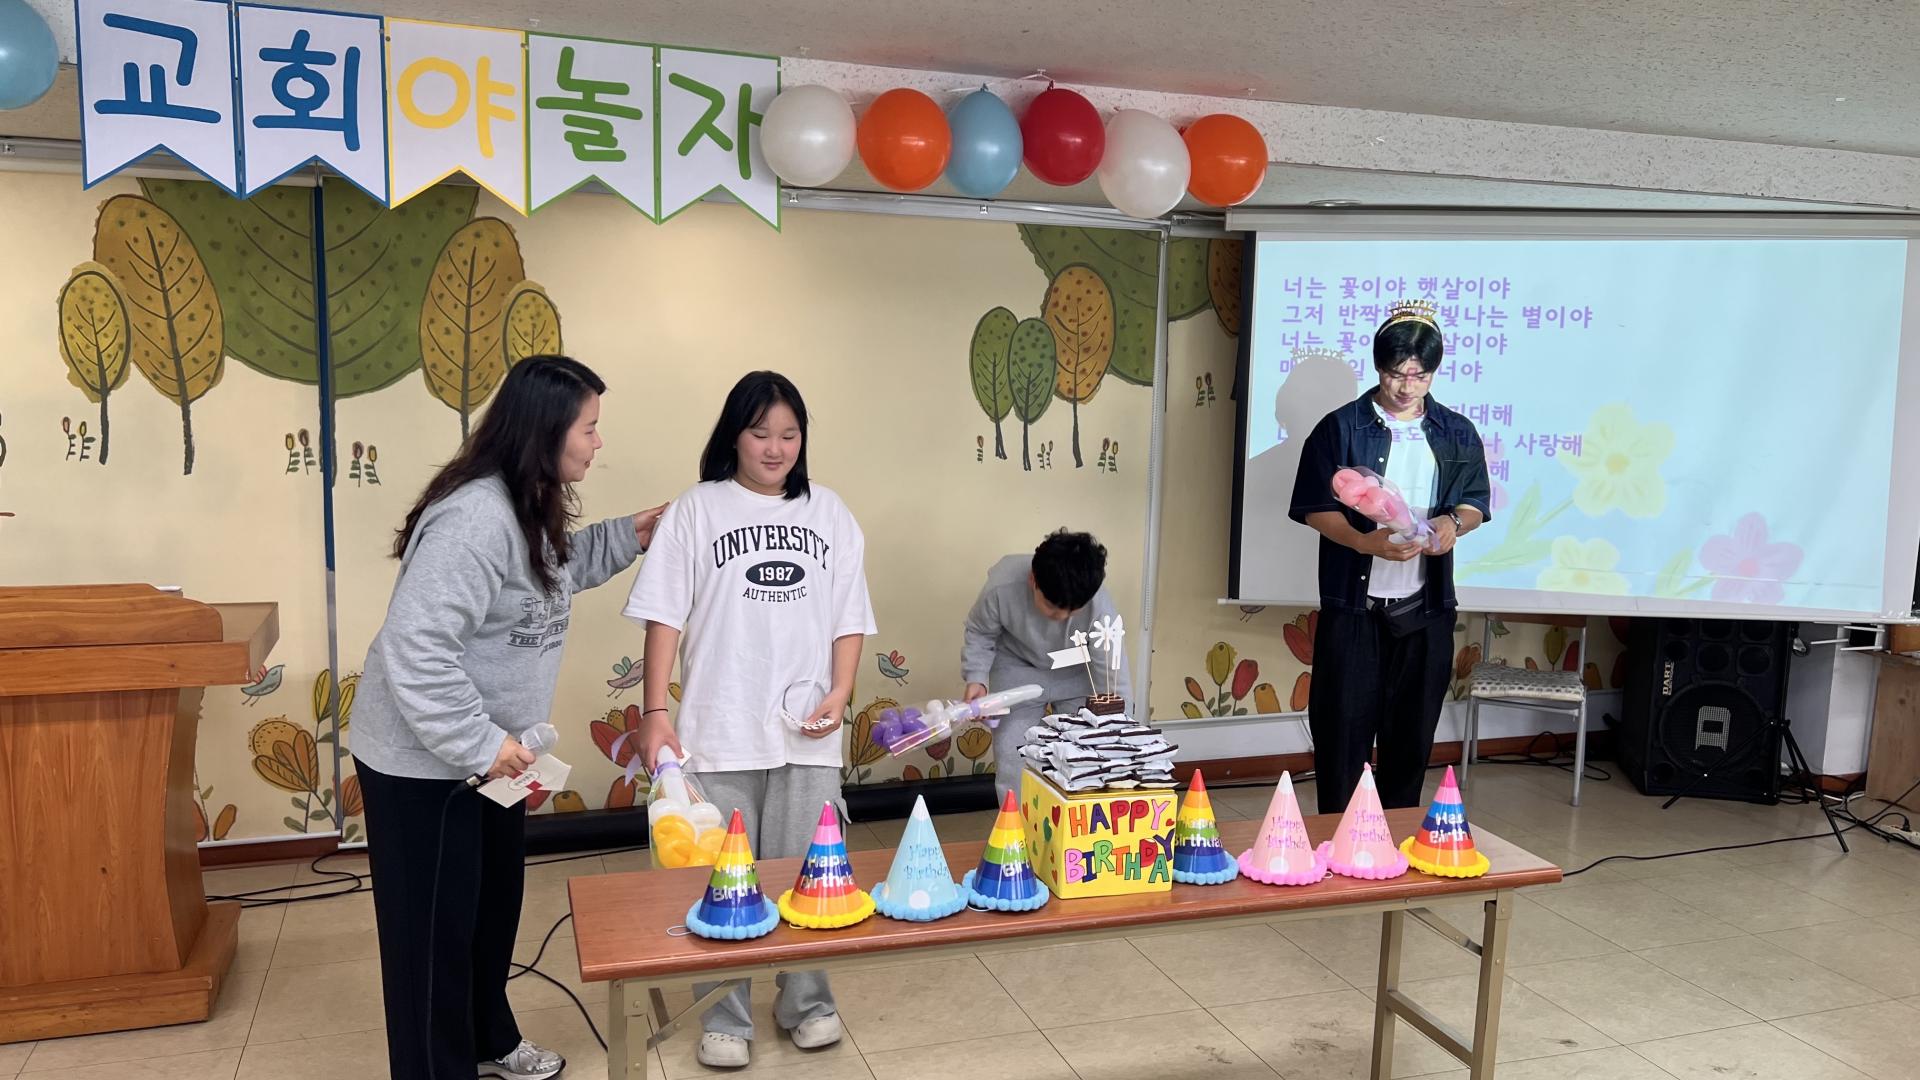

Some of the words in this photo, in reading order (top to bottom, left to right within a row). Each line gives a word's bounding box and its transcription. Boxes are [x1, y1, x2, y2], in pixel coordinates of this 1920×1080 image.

[1283, 276, 1327, 299] 너는
[1339, 276, 1407, 299] 꽃이야
[1417, 276, 1511, 300] 햇살이야
[1282, 303, 1324, 326] 그저
[1441, 304, 1508, 328] 빛나는
[1523, 305, 1592, 328] 별이야
[1514, 433, 1582, 457] 사랑해
[713, 525, 829, 570] UNIVERSITY
[758, 566, 795, 581] 1987
[742, 586, 807, 603] AUTHENTIC
[510, 632, 539, 646] THE
[1662, 661, 1671, 695] DART
[1068, 799, 1171, 838] HAPPY
[1064, 828, 1176, 885] BIRTHDAY
